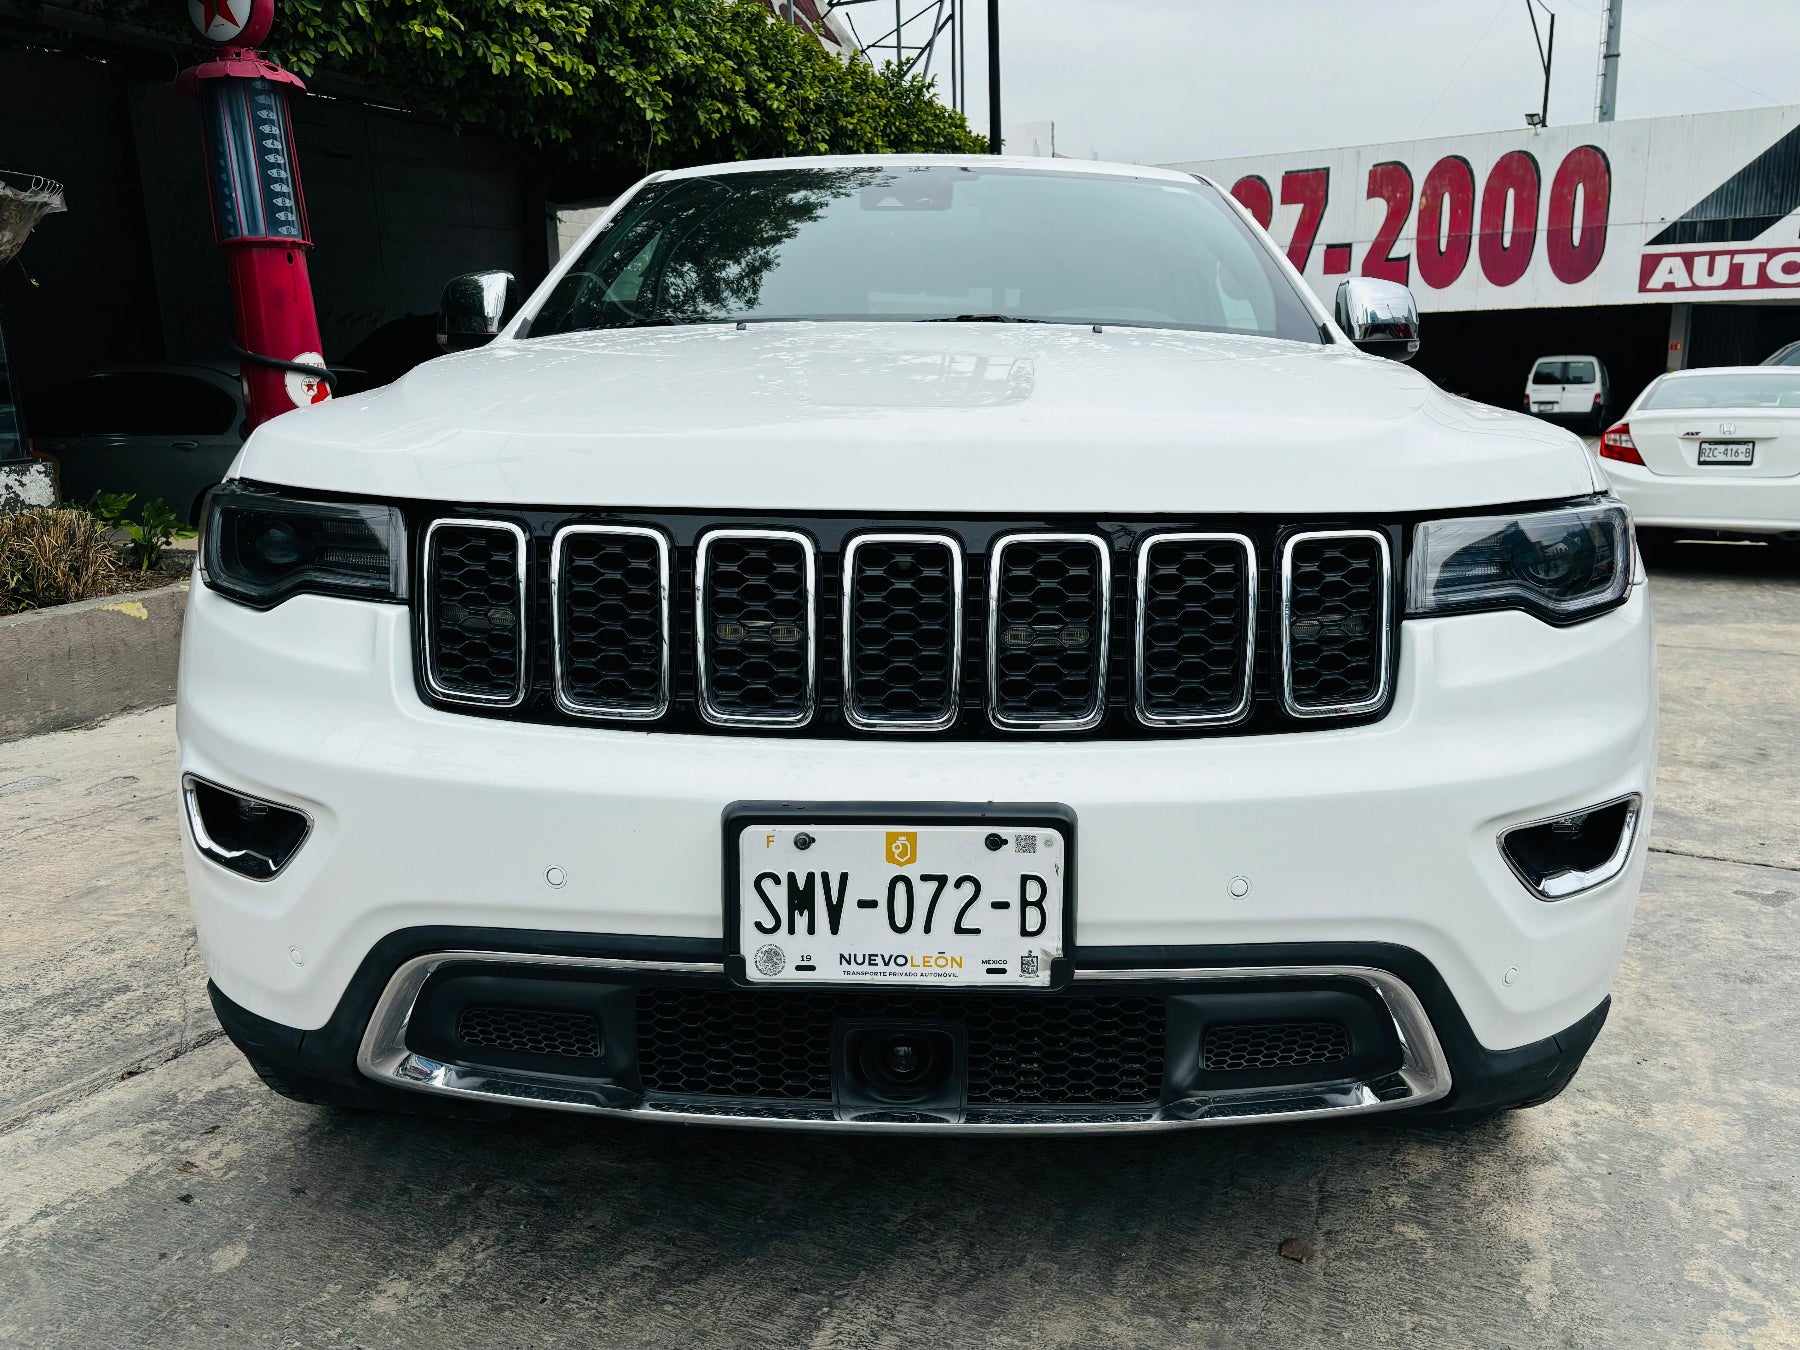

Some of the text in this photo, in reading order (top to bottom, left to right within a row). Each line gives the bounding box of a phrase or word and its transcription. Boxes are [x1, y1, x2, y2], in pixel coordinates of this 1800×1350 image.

[1700, 447, 1751, 458] RZC-416-B
[766, 835, 775, 848] F
[753, 871, 1048, 937] SMV-072-B
